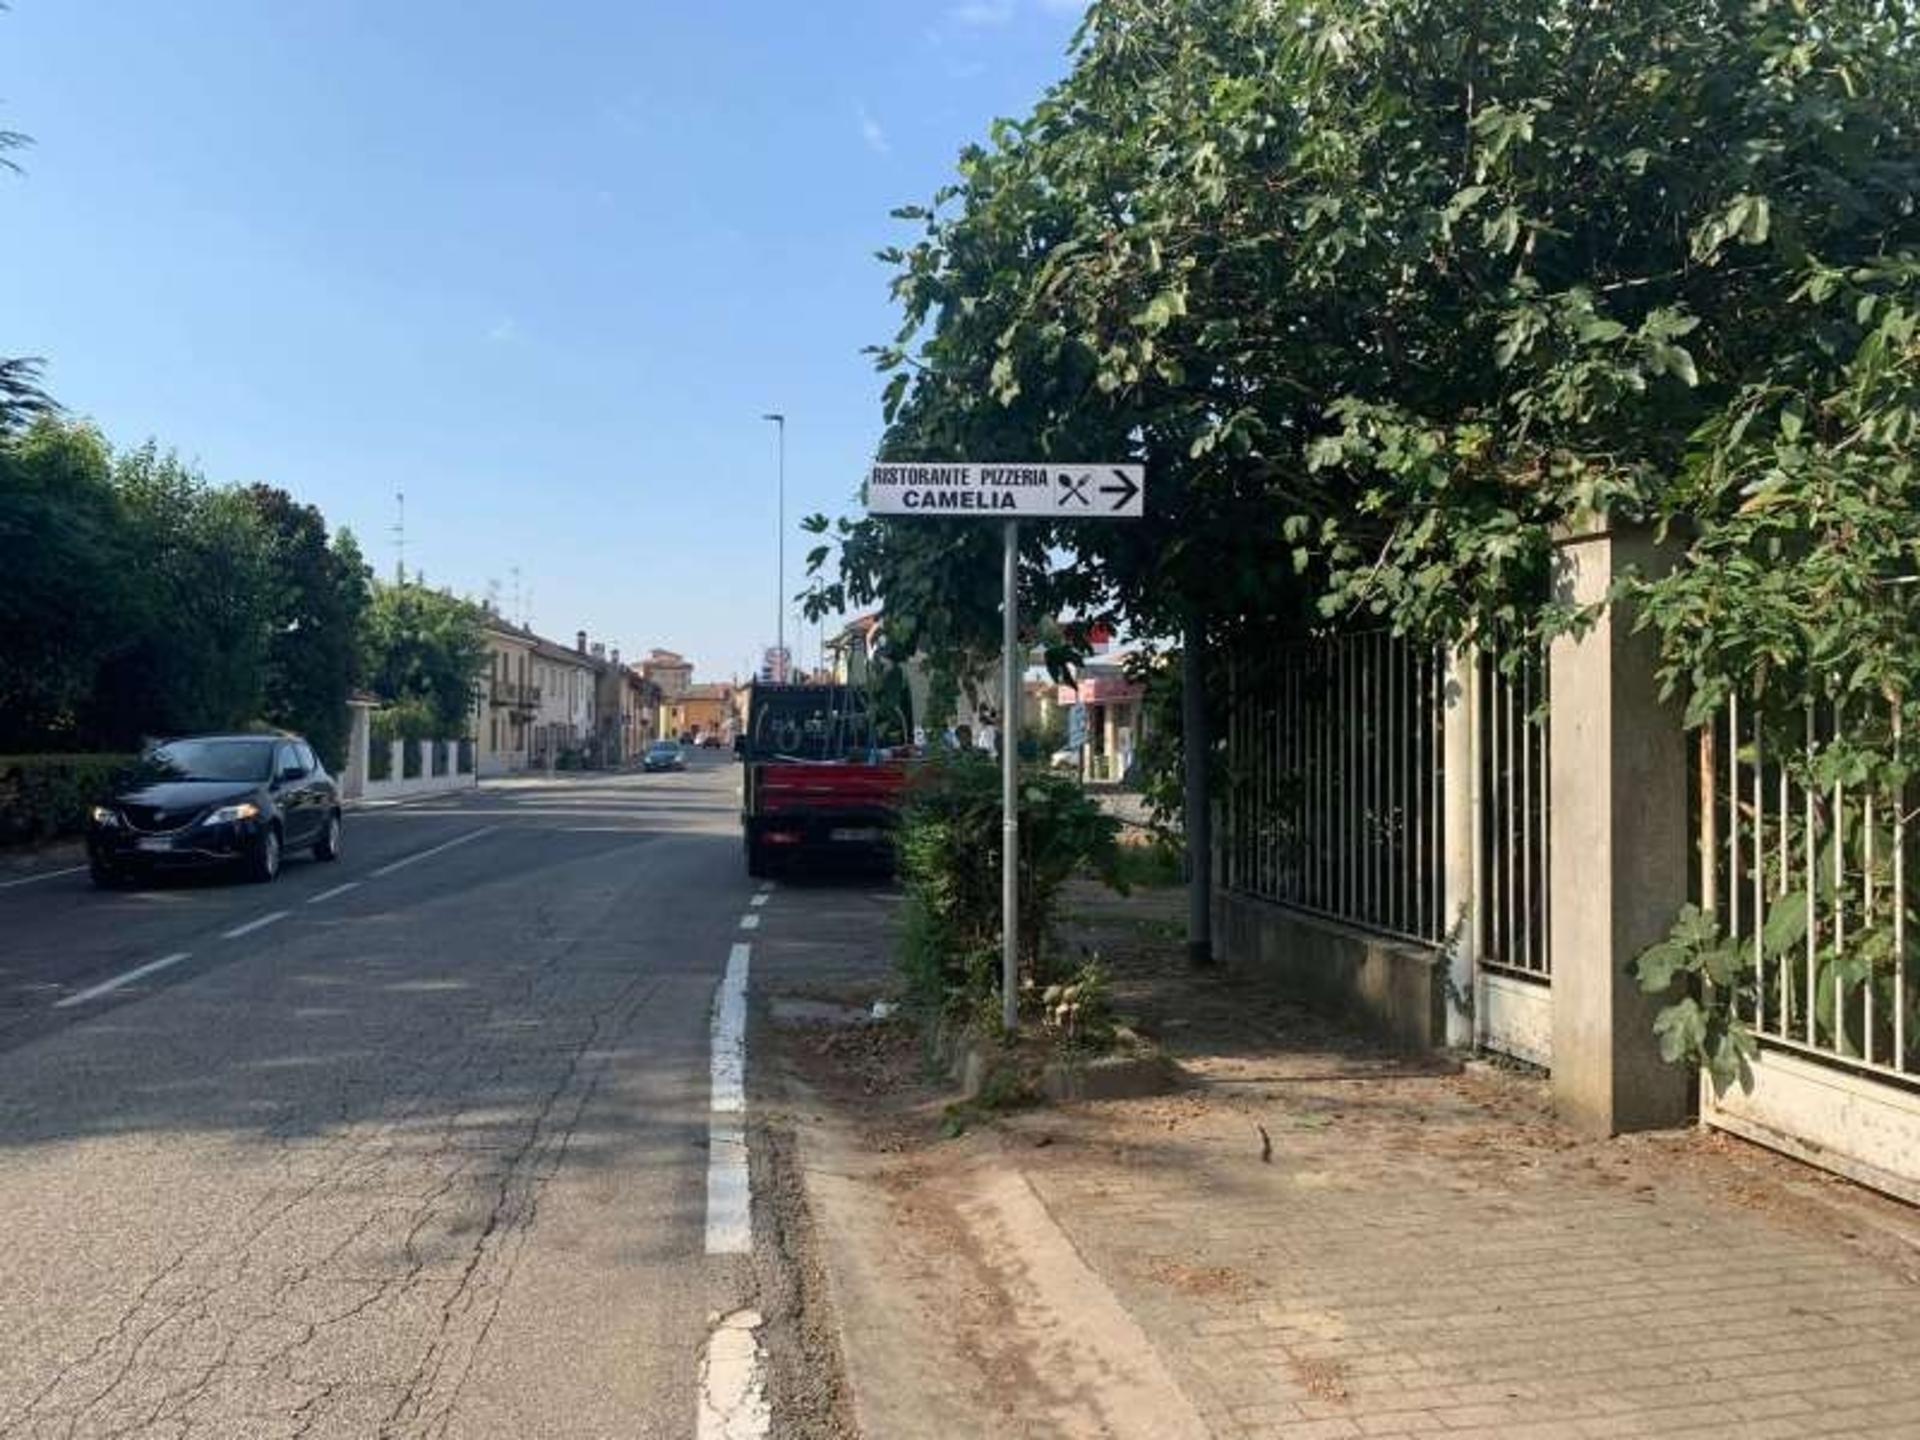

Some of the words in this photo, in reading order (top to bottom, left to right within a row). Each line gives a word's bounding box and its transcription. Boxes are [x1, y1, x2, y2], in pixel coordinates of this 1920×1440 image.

[873, 467, 969, 486] RISTORANTE
[981, 468, 1048, 487] PIZZERIA
[902, 490, 1017, 509] CAMELIA
